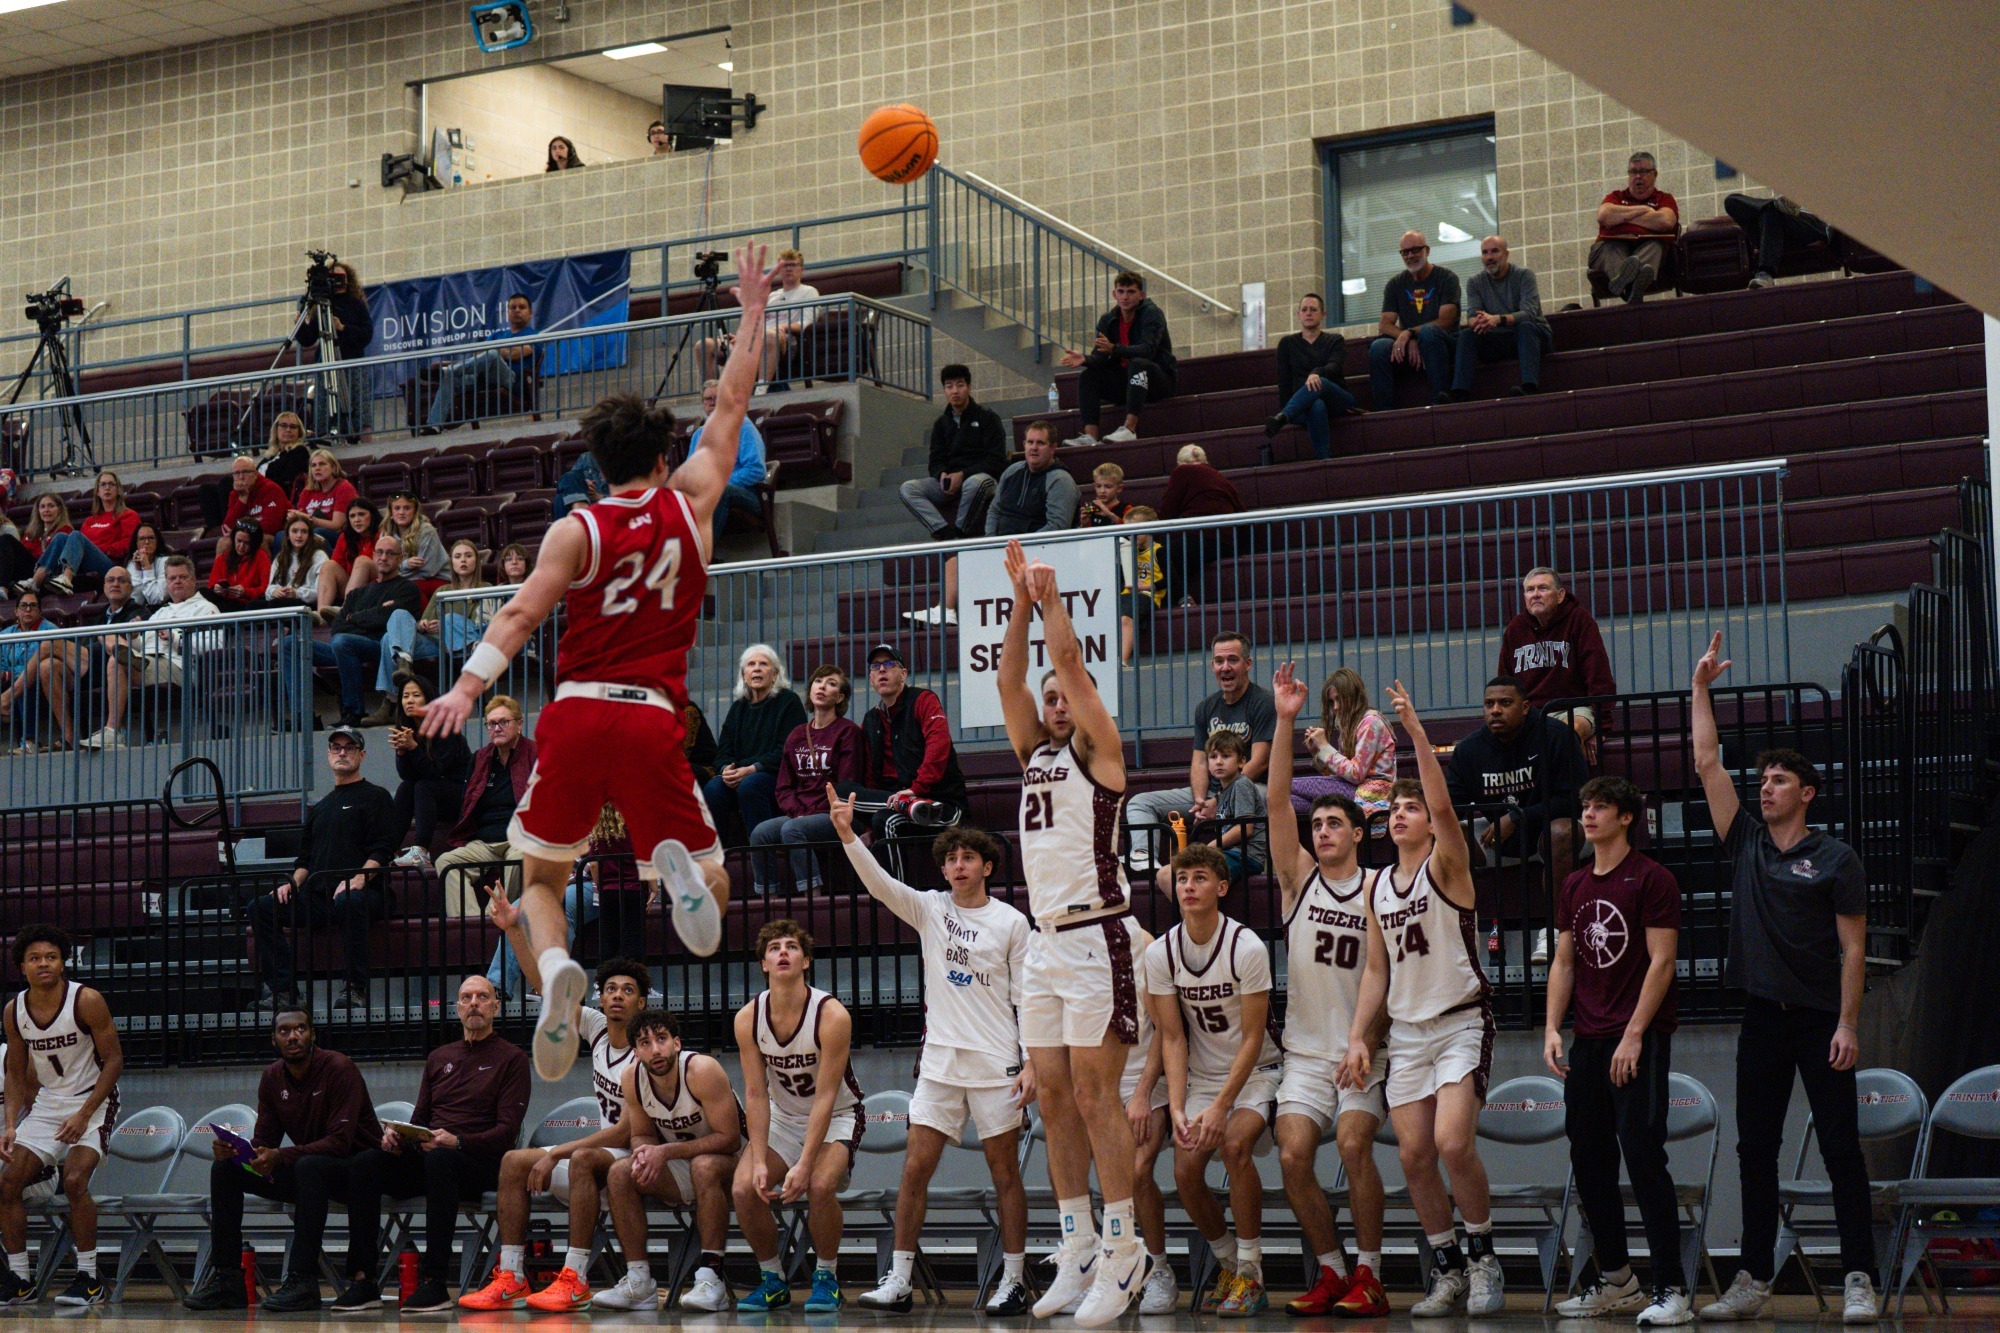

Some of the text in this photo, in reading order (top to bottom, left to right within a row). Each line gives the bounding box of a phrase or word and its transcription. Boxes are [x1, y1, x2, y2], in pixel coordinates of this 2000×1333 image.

[383, 302, 486, 340] DIVISION
[383, 339, 423, 351] DISCOVER
[431, 332, 466, 346] DEVELOP
[601, 537, 682, 615] 24
[973, 588, 1101, 627] TRNTY
[969, 633, 1107, 672] SETN
[1482, 766, 1534, 788] TRINITY
[1024, 790, 1054, 832] 21
[1380, 895, 1429, 930] TIGRS
[1314, 930, 1360, 970] 20
[947, 970, 973, 985] SAA
[1190, 1004, 1230, 1033] 15
[47, 1054, 64, 1077] 1
[1534, 1101, 1565, 1110] TIGERS
[1669, 1098, 1701, 1107] TIGERS
[544, 1119, 577, 1128] TRINITY
